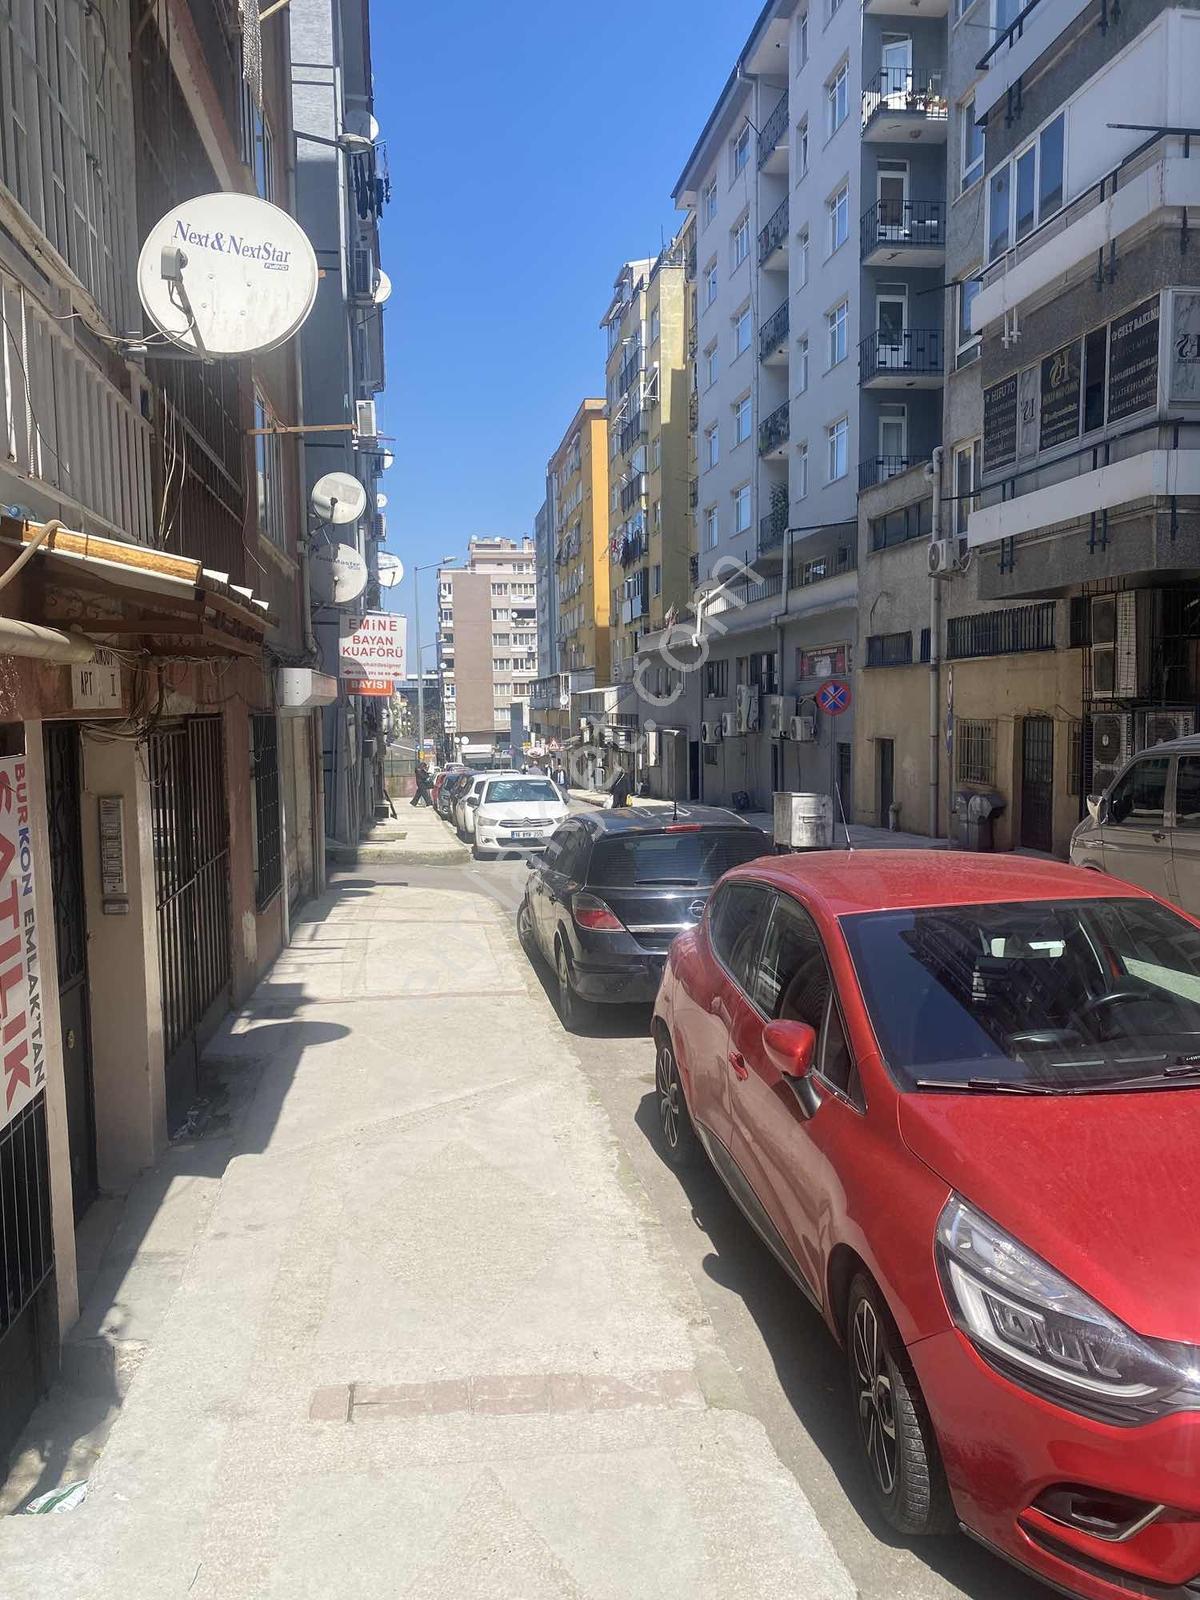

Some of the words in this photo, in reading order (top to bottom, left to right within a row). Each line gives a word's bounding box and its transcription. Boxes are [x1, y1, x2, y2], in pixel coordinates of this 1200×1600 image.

[352, 635, 393, 645] BAYAN
[342, 646, 403, 658] KUAFÖRÜ
[14, 763, 33, 896] BURKON
[24, 907, 45, 1087] EMLAK'TAN
